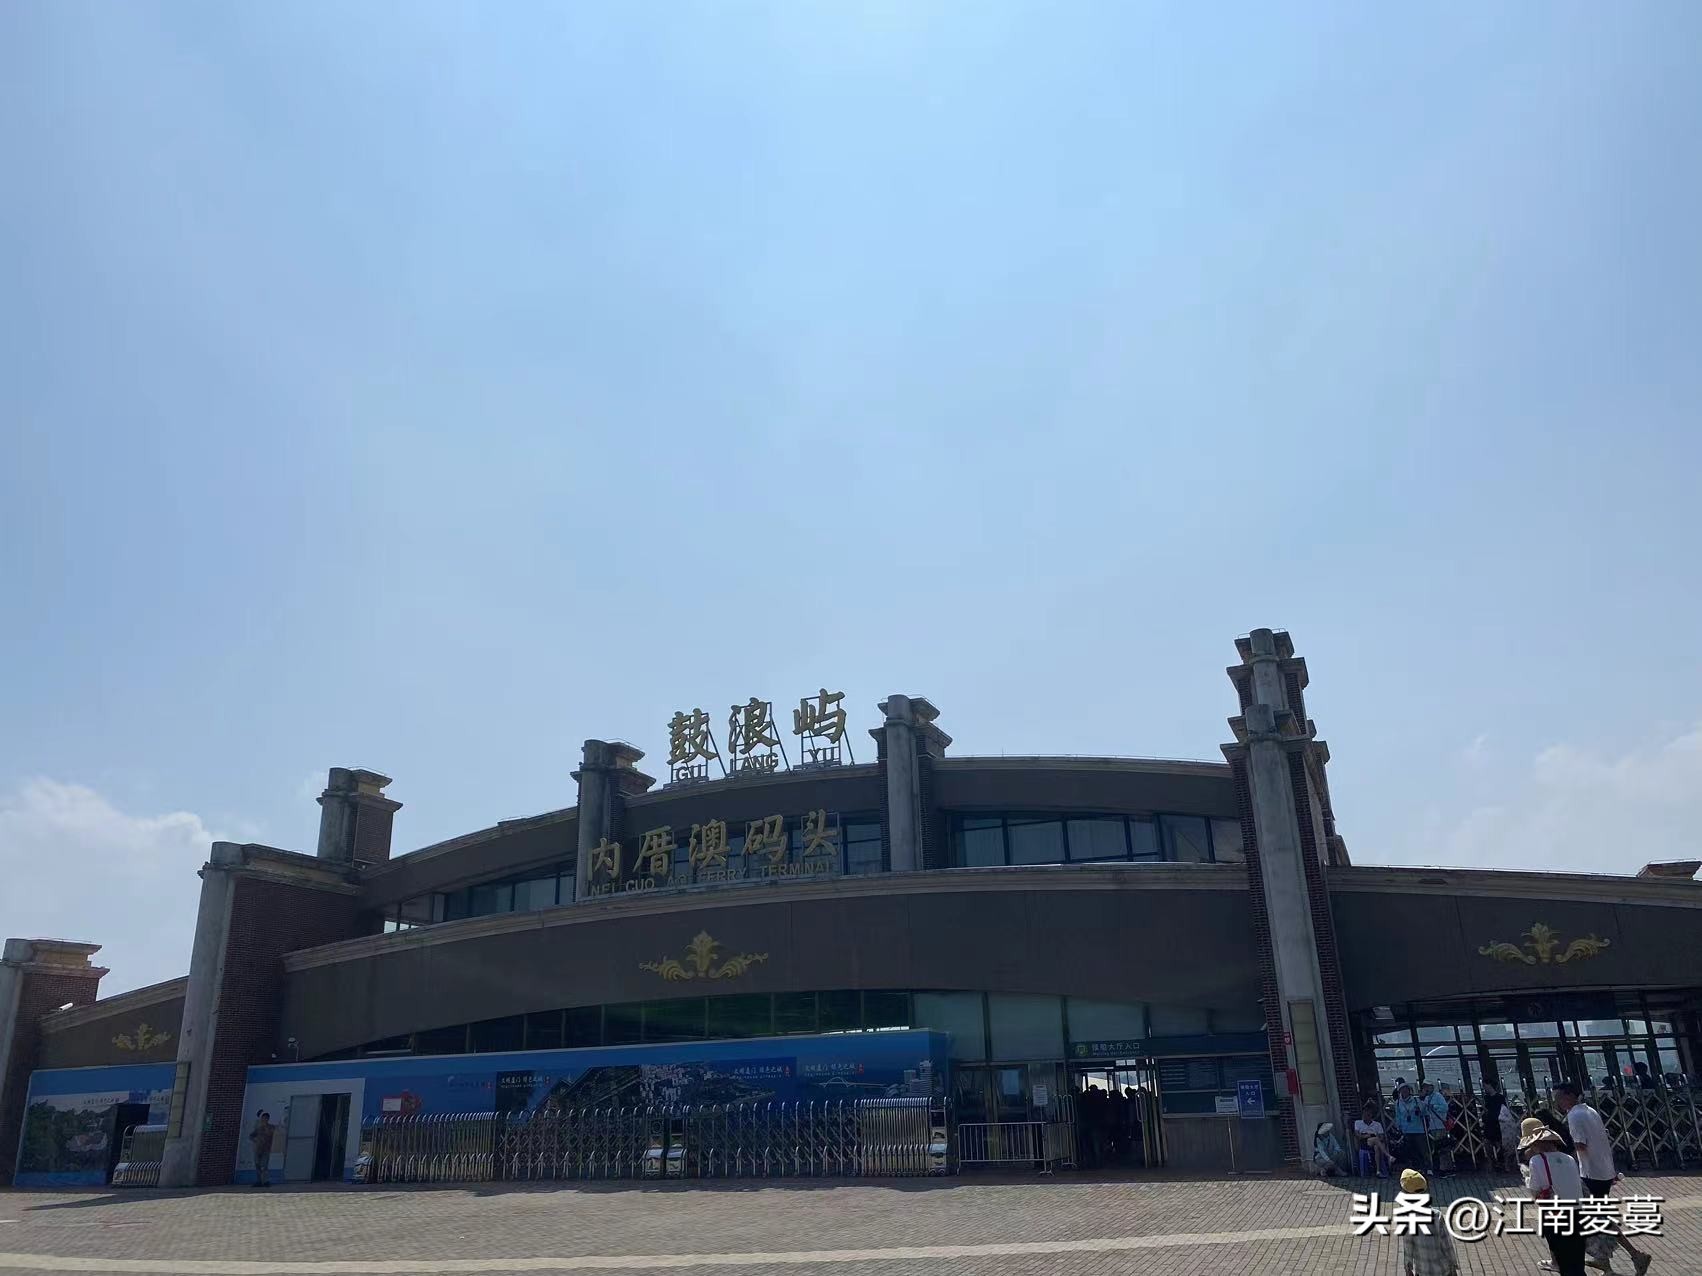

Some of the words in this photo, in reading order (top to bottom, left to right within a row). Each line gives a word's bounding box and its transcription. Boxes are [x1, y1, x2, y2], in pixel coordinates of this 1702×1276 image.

[667, 688, 846, 765] 鼓浪屿
[675, 764, 702, 780] GU
[807, 747, 834, 762] YU
[590, 809, 838, 880] 内厝澳码头
[625, 878, 655, 891] CUO
